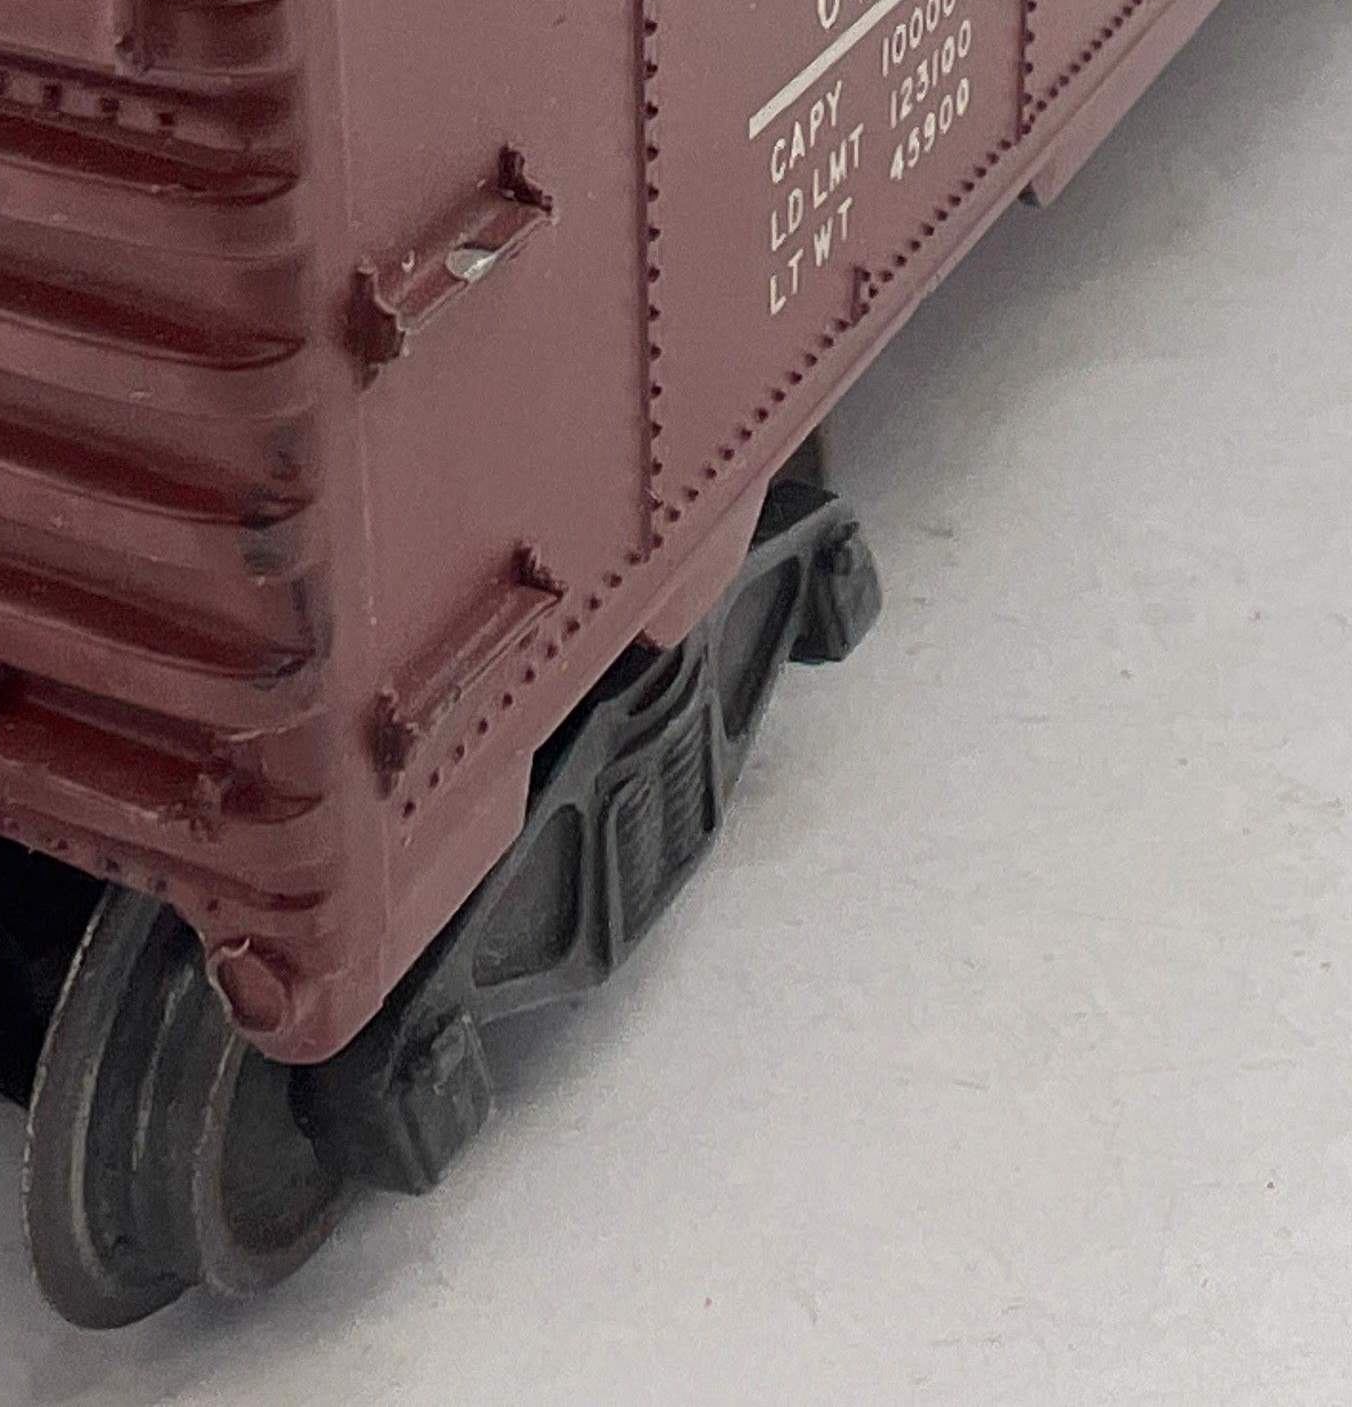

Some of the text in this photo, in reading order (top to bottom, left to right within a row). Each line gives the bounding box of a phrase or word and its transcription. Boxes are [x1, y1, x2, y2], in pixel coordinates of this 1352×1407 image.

[770, 80, 842, 184] CAPY
[770, 77, 970, 316] LT WT 45900
[771, 19, 972, 253] LD LMT 123100
